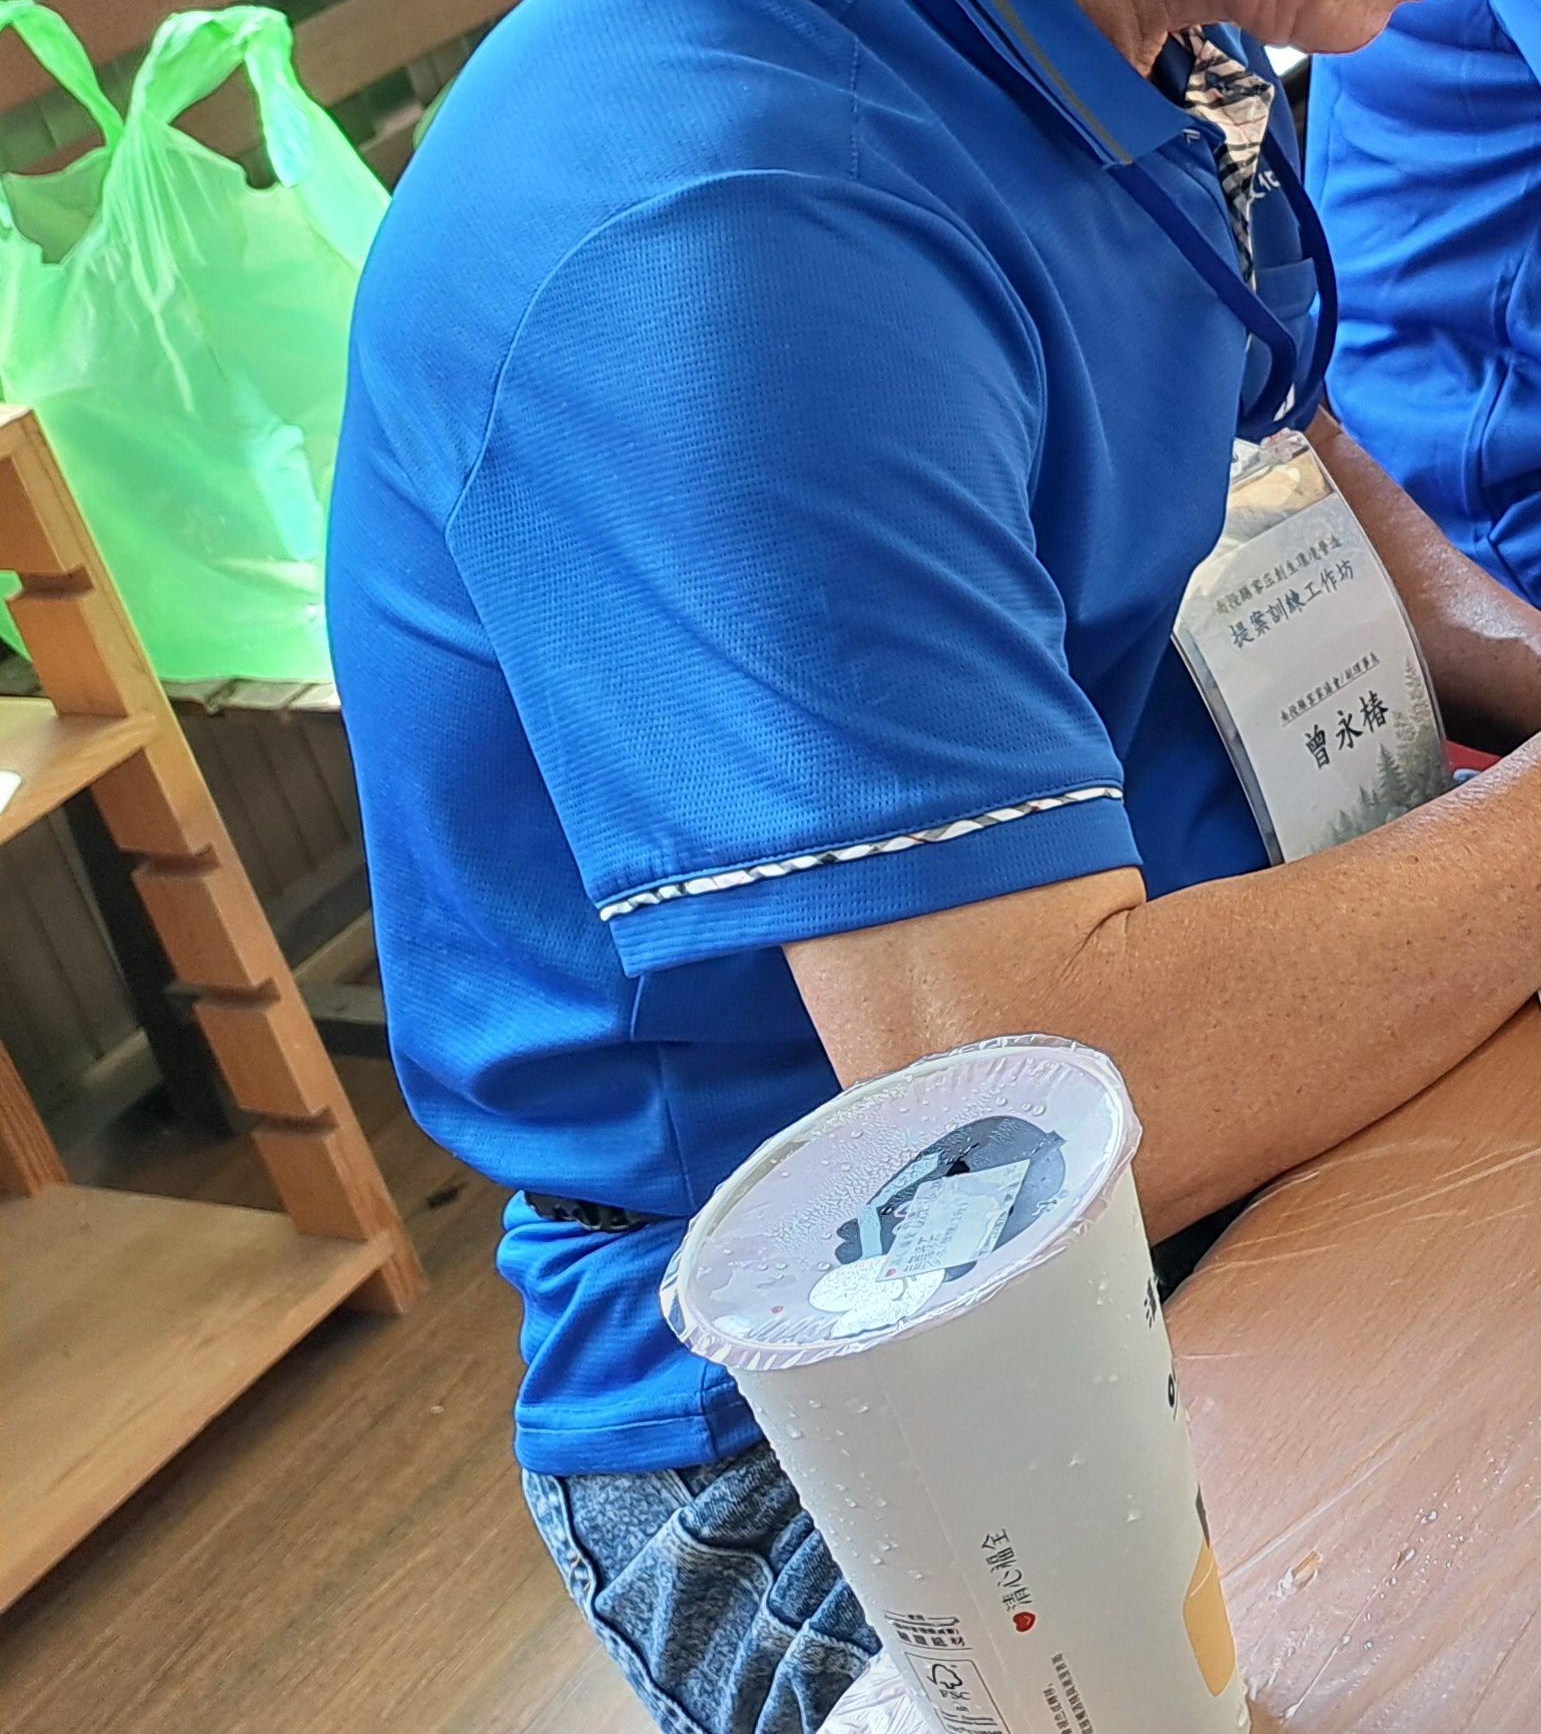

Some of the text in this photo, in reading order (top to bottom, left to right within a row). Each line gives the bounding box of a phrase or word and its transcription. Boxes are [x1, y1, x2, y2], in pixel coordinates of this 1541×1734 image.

[1229, 560, 1353, 648] 提案訓練工作坊
[1303, 691, 1390, 770] 曾永椿
[980, 1528, 1033, 1612] 清心福全
